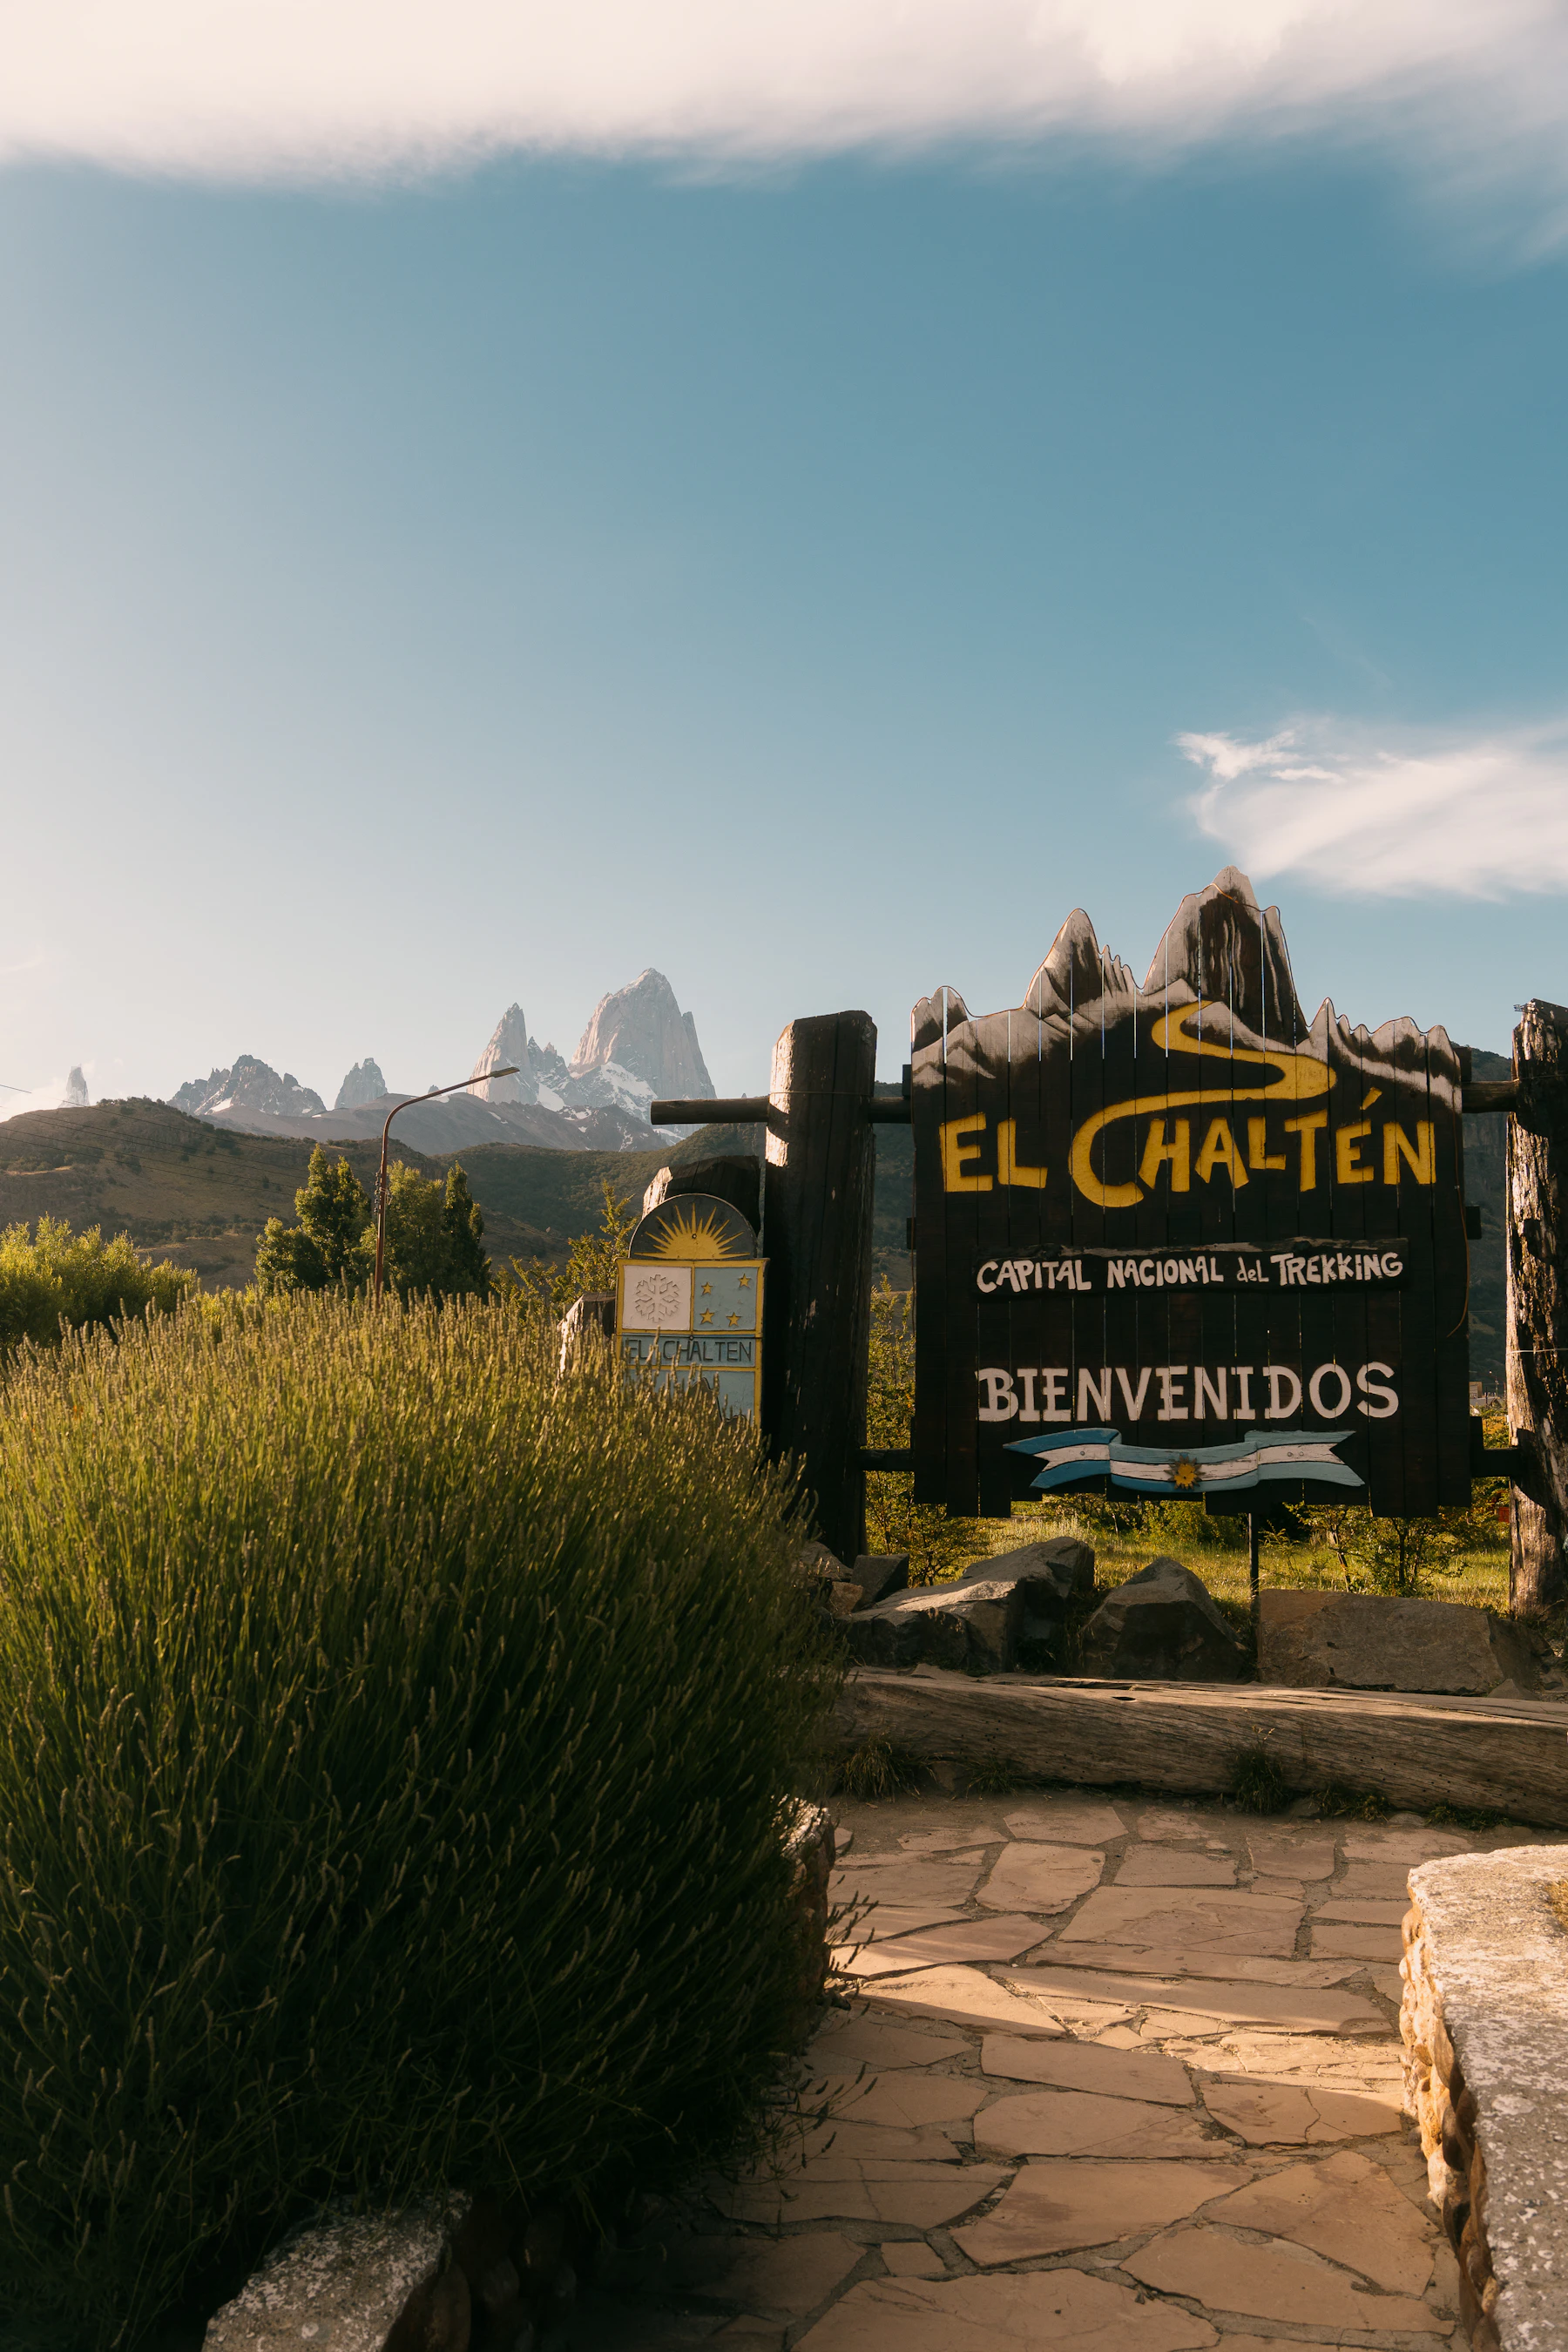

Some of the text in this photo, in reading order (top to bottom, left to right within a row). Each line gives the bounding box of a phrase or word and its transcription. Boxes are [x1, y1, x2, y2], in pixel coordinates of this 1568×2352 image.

[939, 1087, 1437, 1208] EL CHALTÉN
[977, 1259, 1092, 1294] CAPITAL
[1106, 1254, 1224, 1288] NACIONAL
[1270, 1252, 1404, 1287] TREKKING
[625, 1339, 753, 1362] EL CHALTEN
[974, 1361, 1400, 1423] BIENVENIDOS
